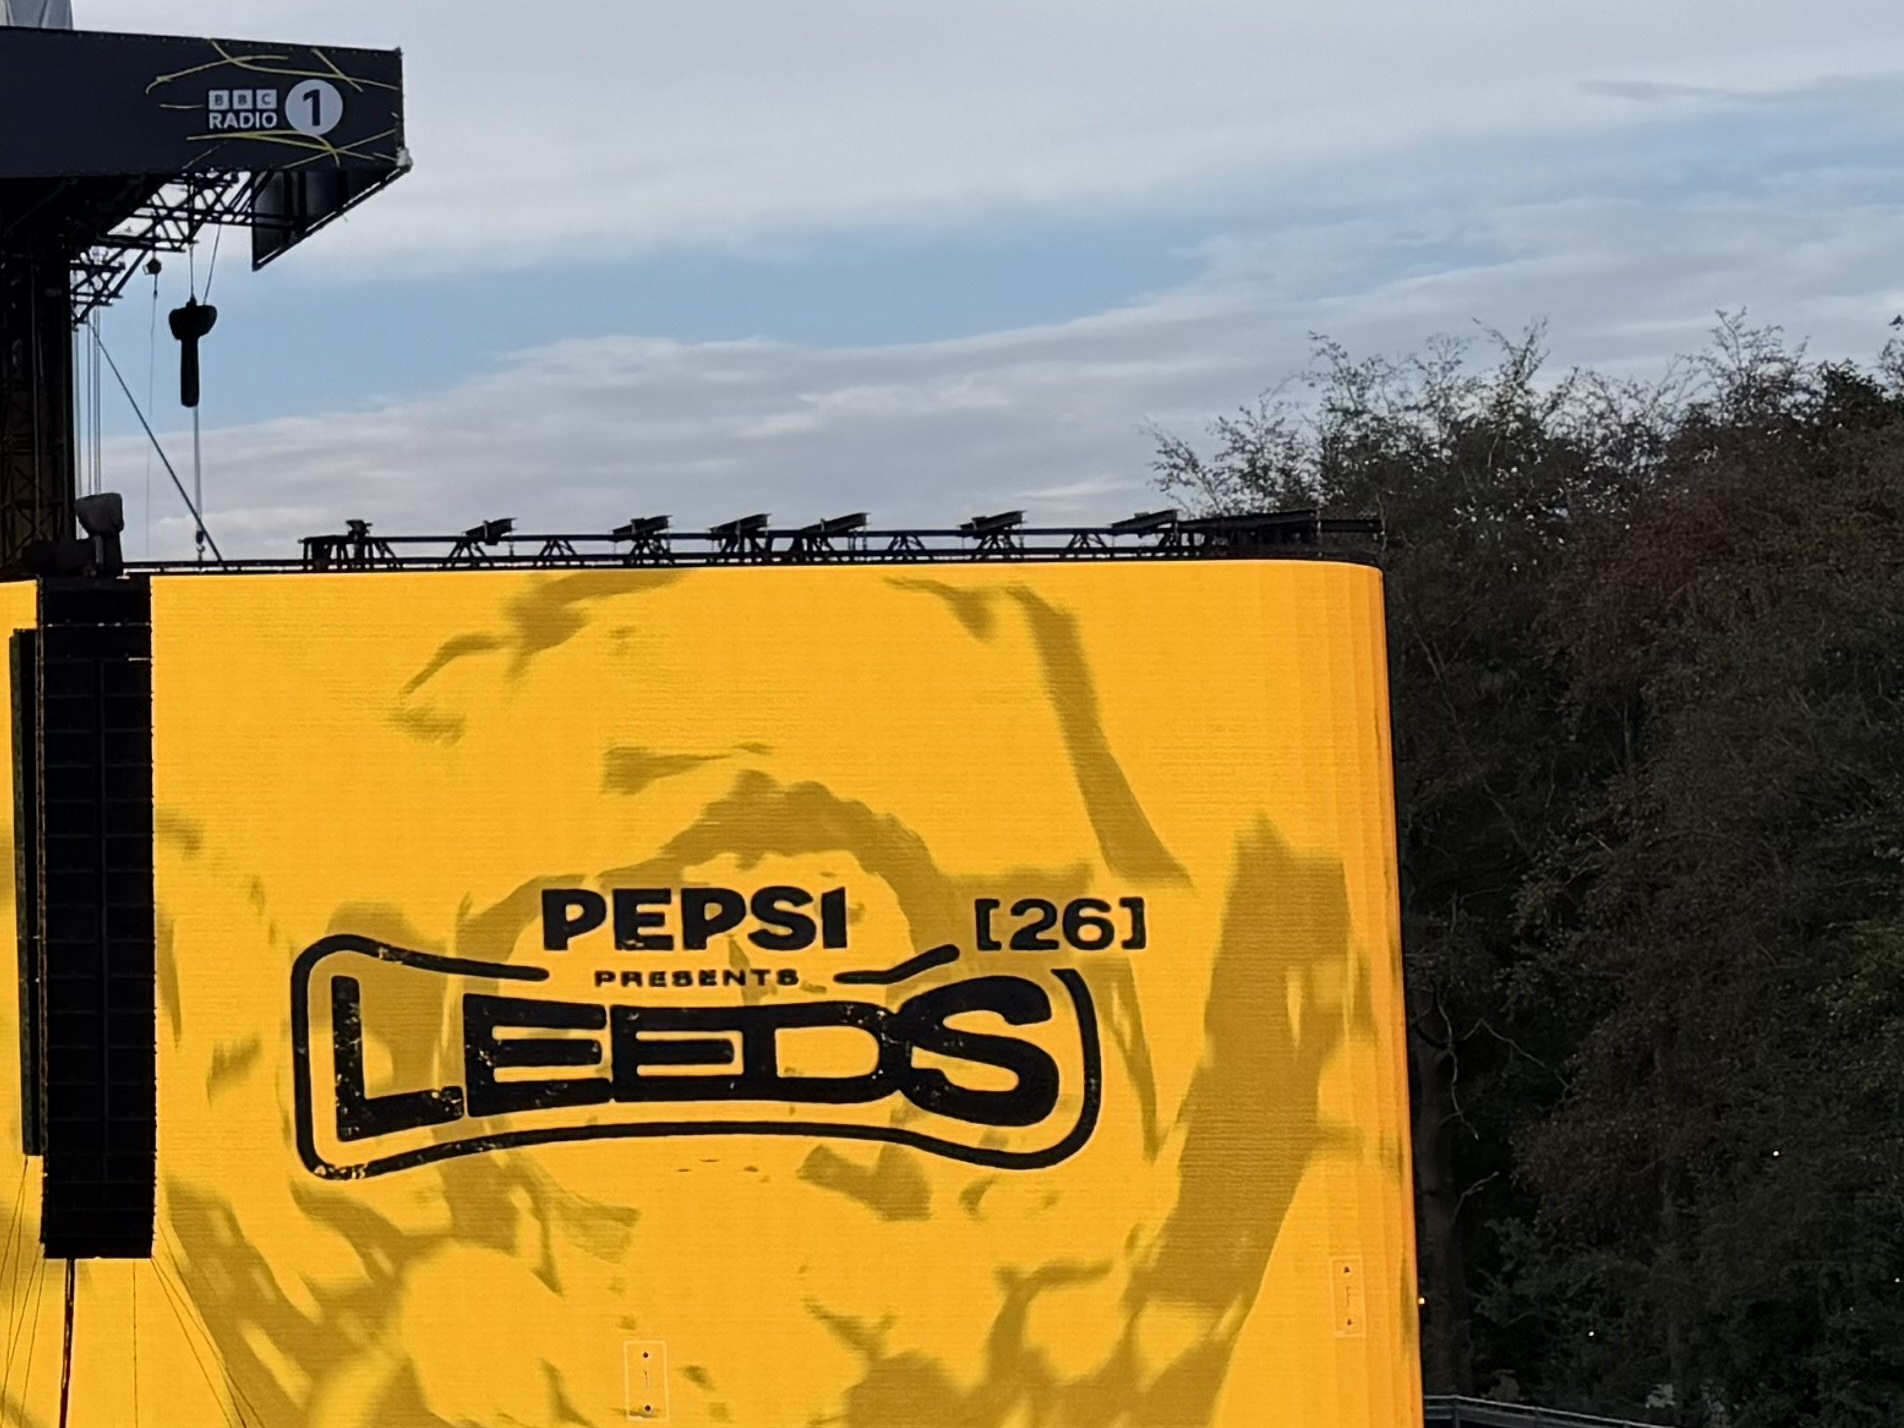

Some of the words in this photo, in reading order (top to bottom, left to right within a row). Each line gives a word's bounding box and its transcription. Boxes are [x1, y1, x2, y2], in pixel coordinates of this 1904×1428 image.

[208, 89, 278, 110] BBC
[208, 112, 278, 129] RADIO
[541, 886, 848, 950] PEPSI
[974, 898, 1146, 950] [26]
[594, 970, 800, 988] PRESENTS
[331, 975, 1060, 1142] LEEDS
